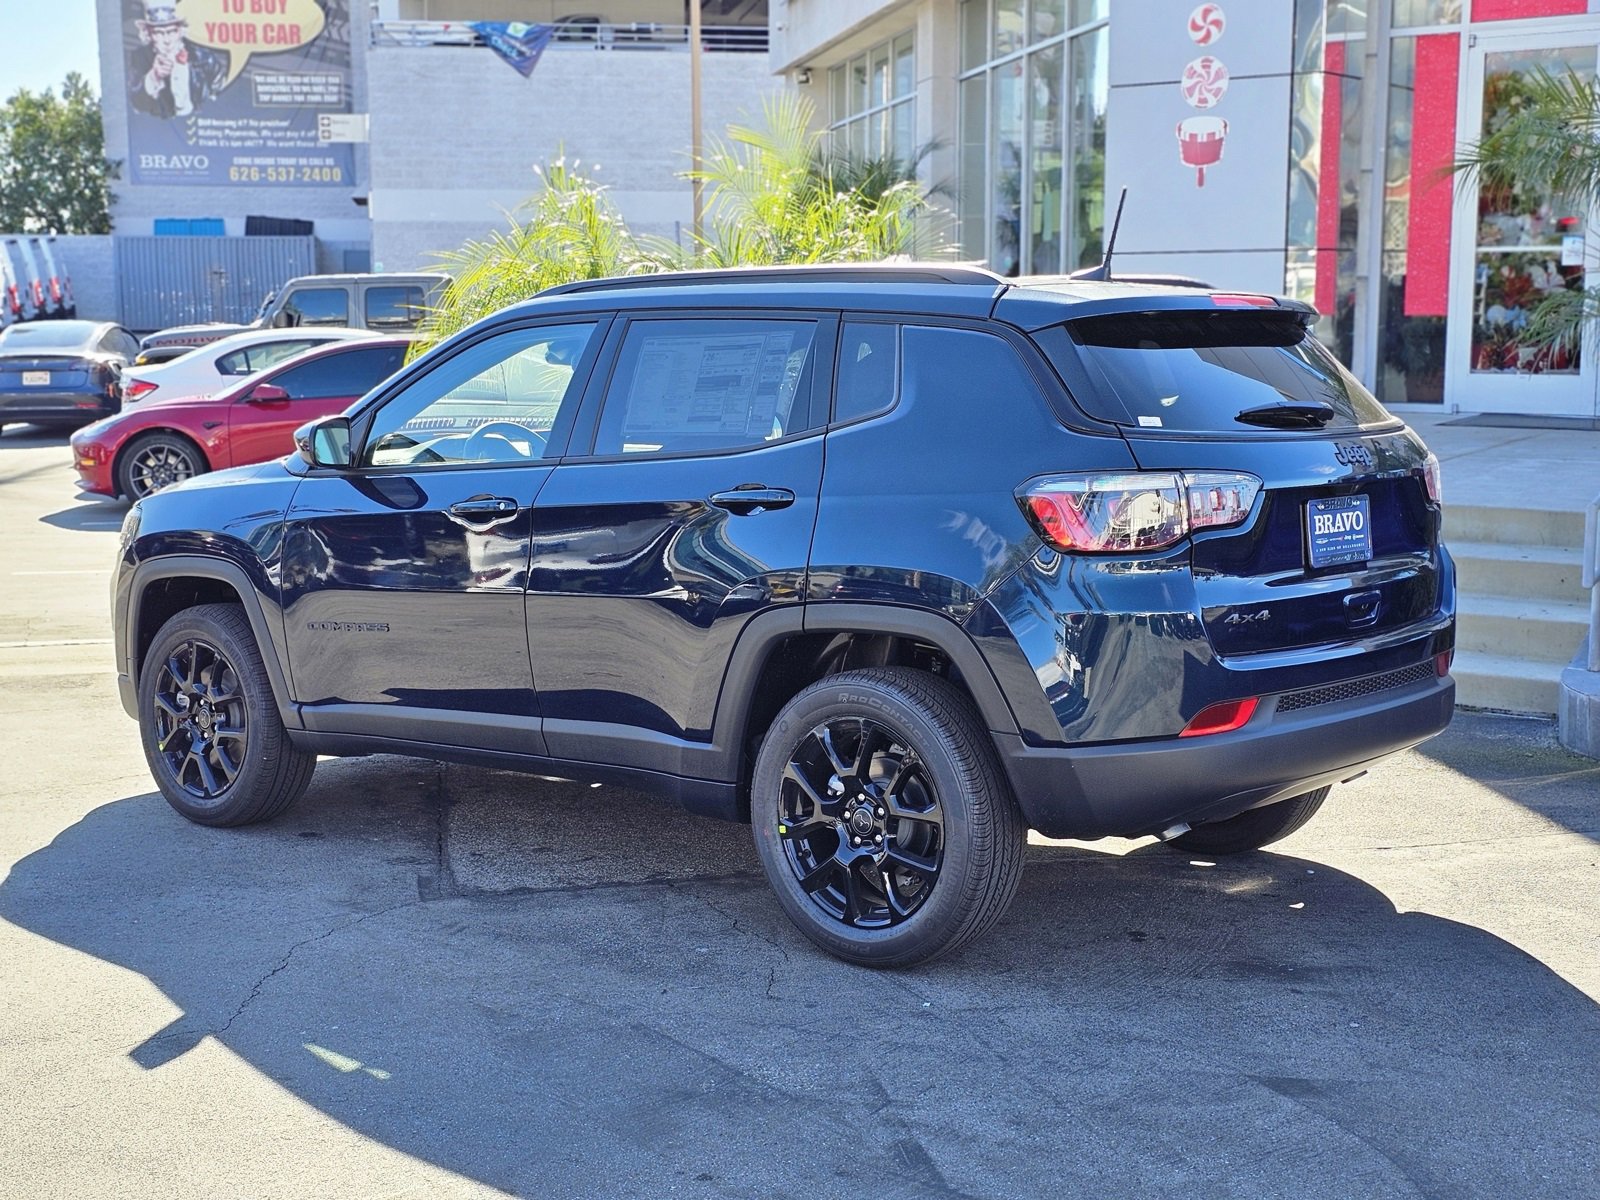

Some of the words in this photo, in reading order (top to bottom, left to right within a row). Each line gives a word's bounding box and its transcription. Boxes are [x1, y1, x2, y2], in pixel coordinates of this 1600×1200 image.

[223, 0, 245, 13] TO
[250, 0, 287, 14] BUY
[205, 22, 257, 44] YOUR
[263, 23, 302, 45] CAR
[140, 154, 209, 169] BRAVO
[230, 166, 342, 182] 626-537-2400
[1333, 442, 1372, 468] Jeep
[1313, 510, 1364, 535] BRAVO
[1224, 609, 1271, 624] 4x4
[307, 621, 390, 632] COMPASS
